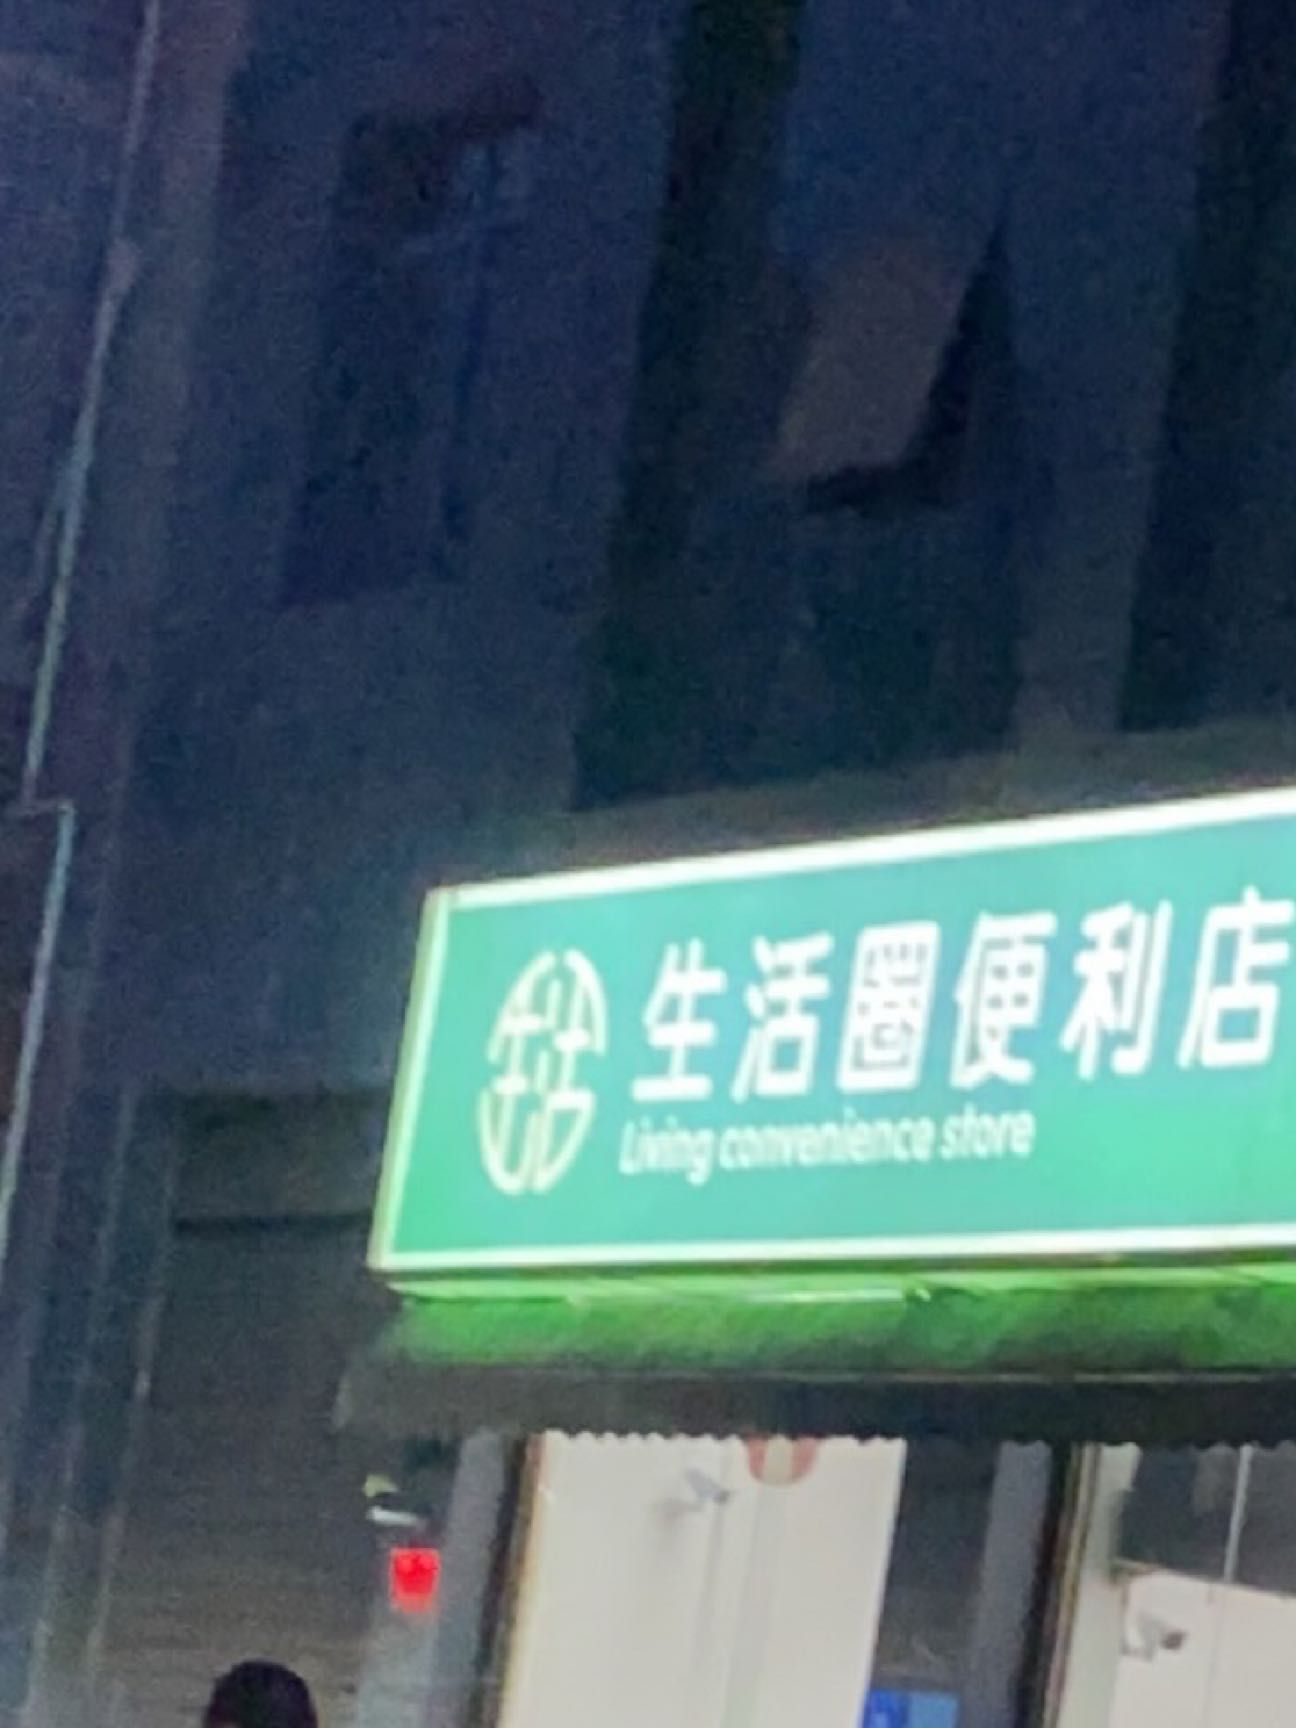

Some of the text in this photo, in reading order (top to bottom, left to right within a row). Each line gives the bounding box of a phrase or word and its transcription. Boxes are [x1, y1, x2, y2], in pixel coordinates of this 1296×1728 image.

[631, 886, 1296, 1103] 生活圈便利店
[618, 1103, 1037, 1187] Living convenience store
